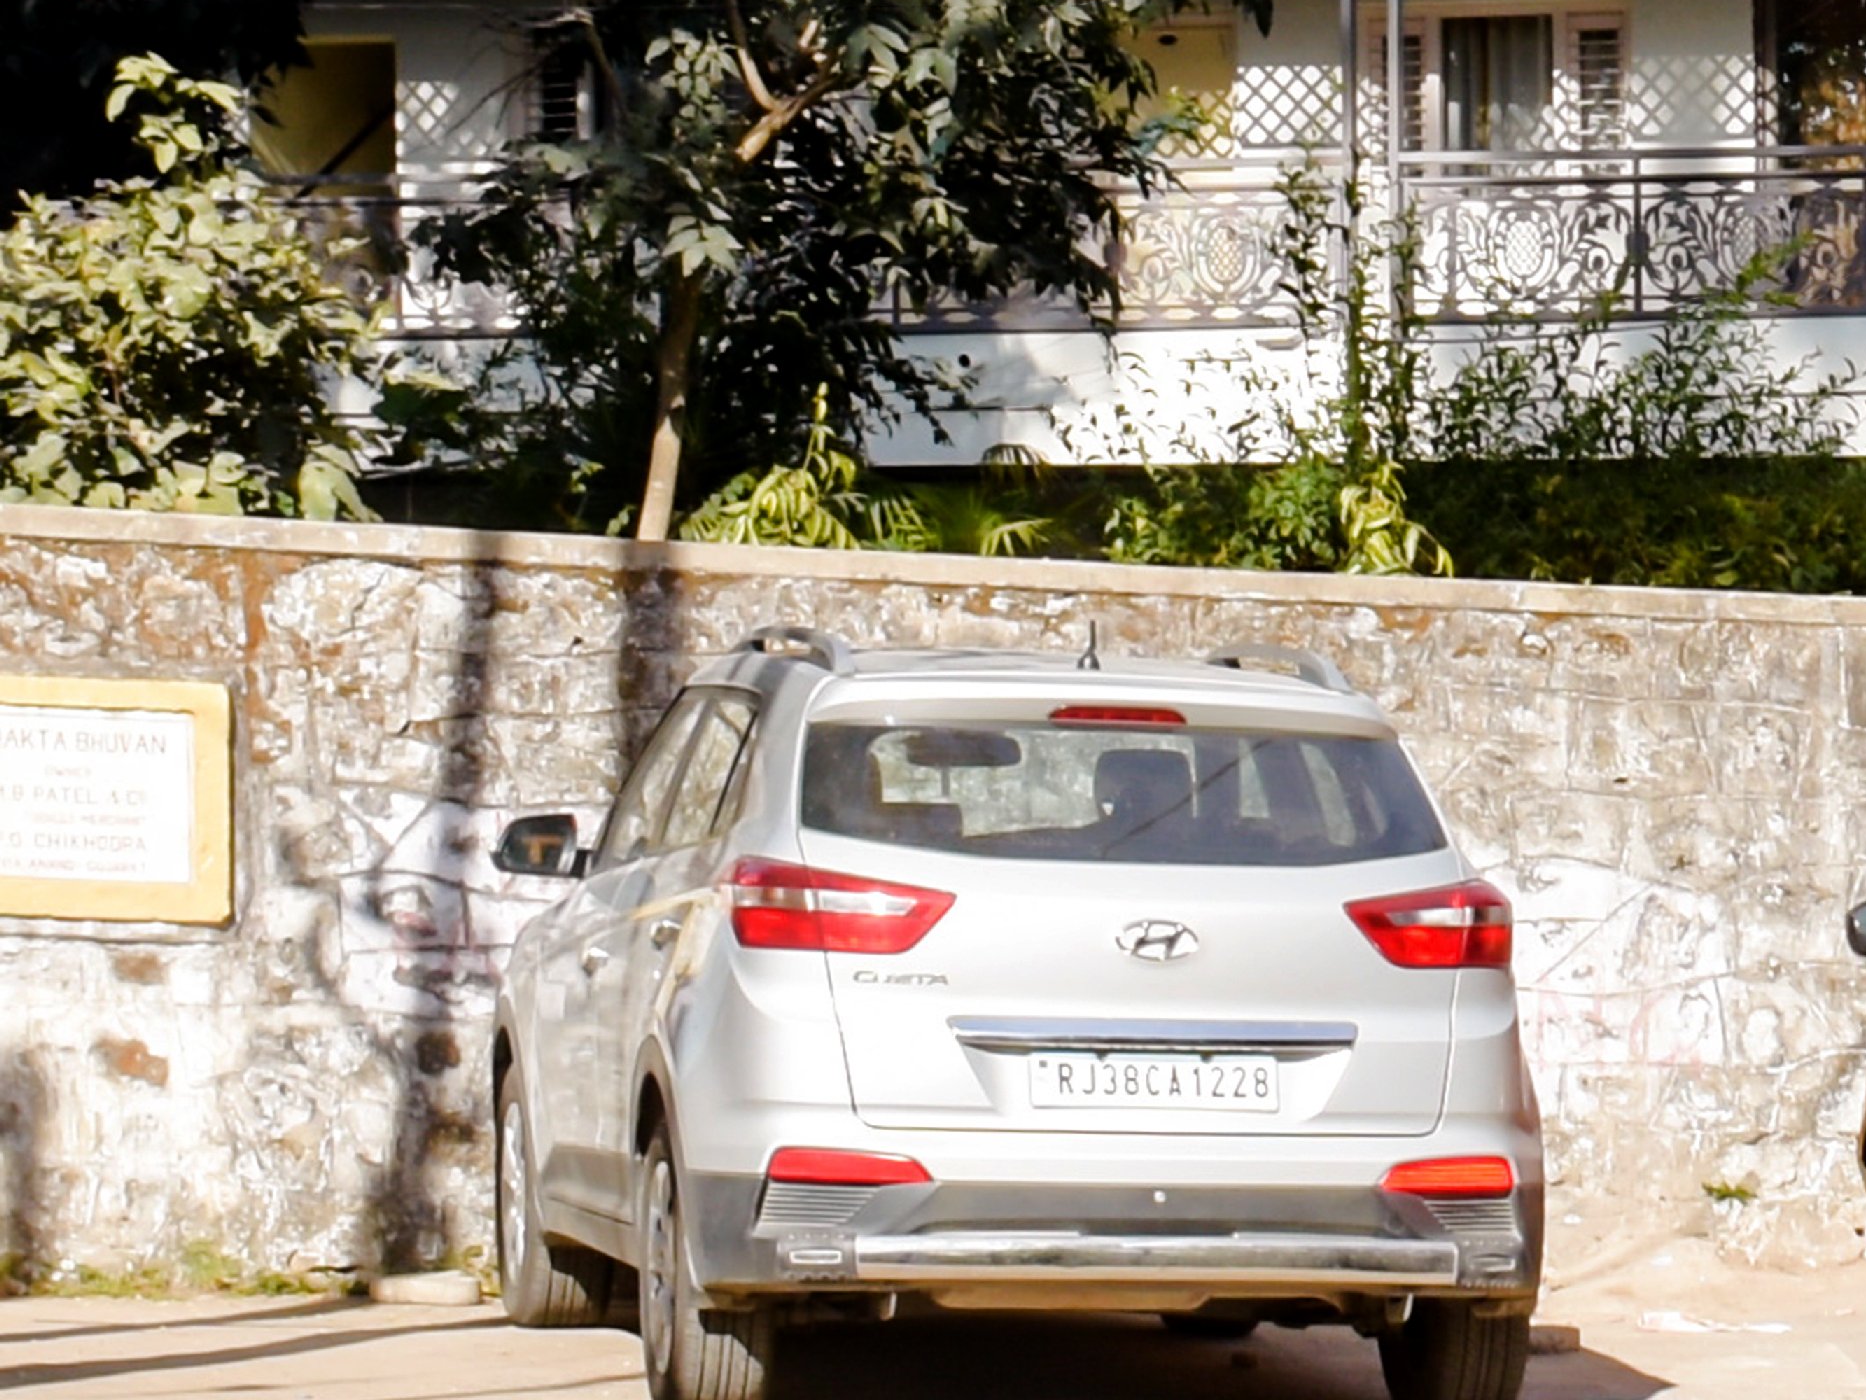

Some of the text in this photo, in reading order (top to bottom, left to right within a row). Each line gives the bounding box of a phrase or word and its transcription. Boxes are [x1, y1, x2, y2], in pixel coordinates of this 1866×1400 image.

[0, 728, 67, 751] AKTA
[33, 787, 98, 805] PATEL
[1057, 1063, 1269, 1098] RJ38CA1228
